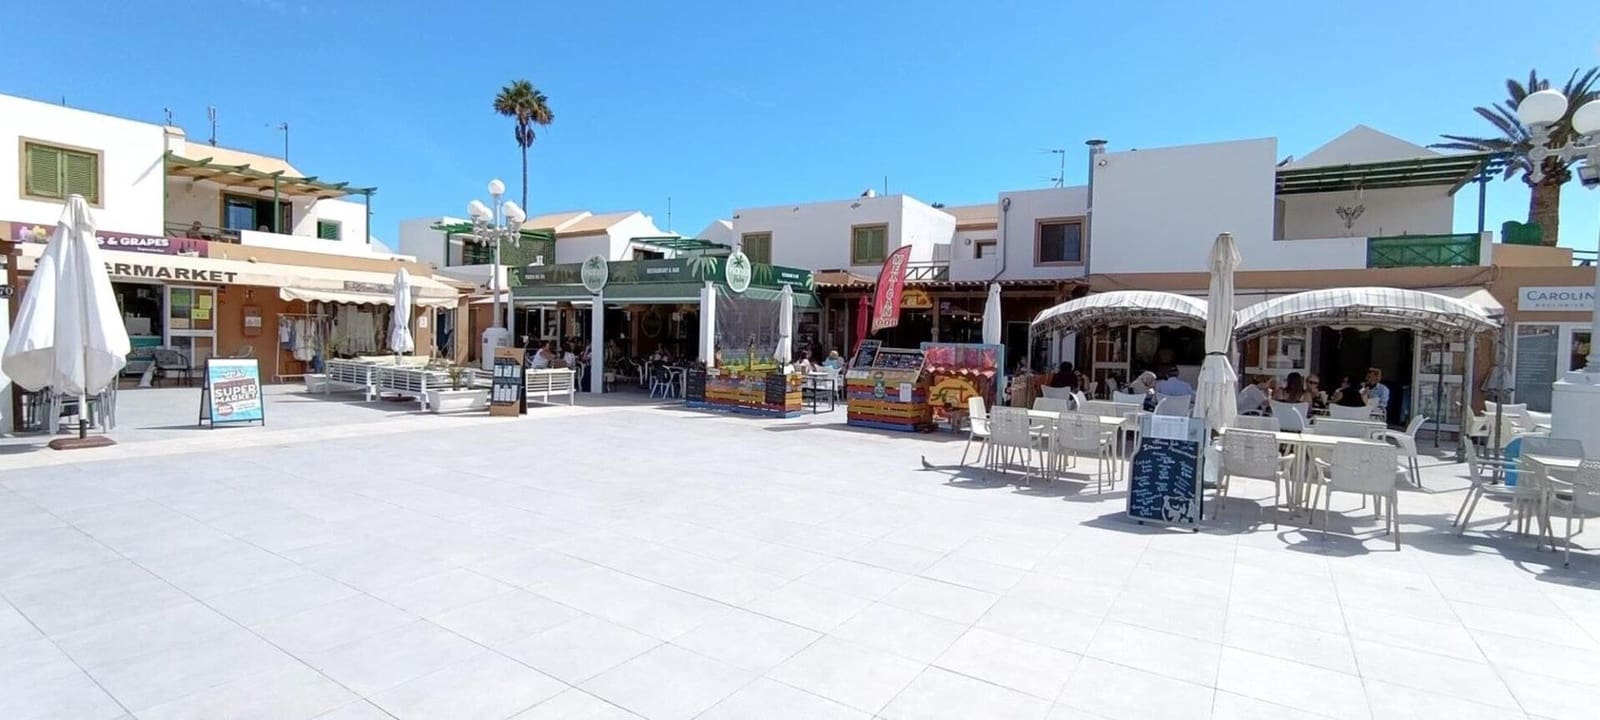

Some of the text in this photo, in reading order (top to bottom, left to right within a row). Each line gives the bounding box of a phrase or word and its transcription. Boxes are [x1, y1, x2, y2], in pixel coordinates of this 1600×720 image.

[120, 237, 169, 247] GRAPES
[882, 254, 903, 318] MEXICAN
[215, 384, 257, 399] SUPER
[216, 392, 256, 404] MARKET
